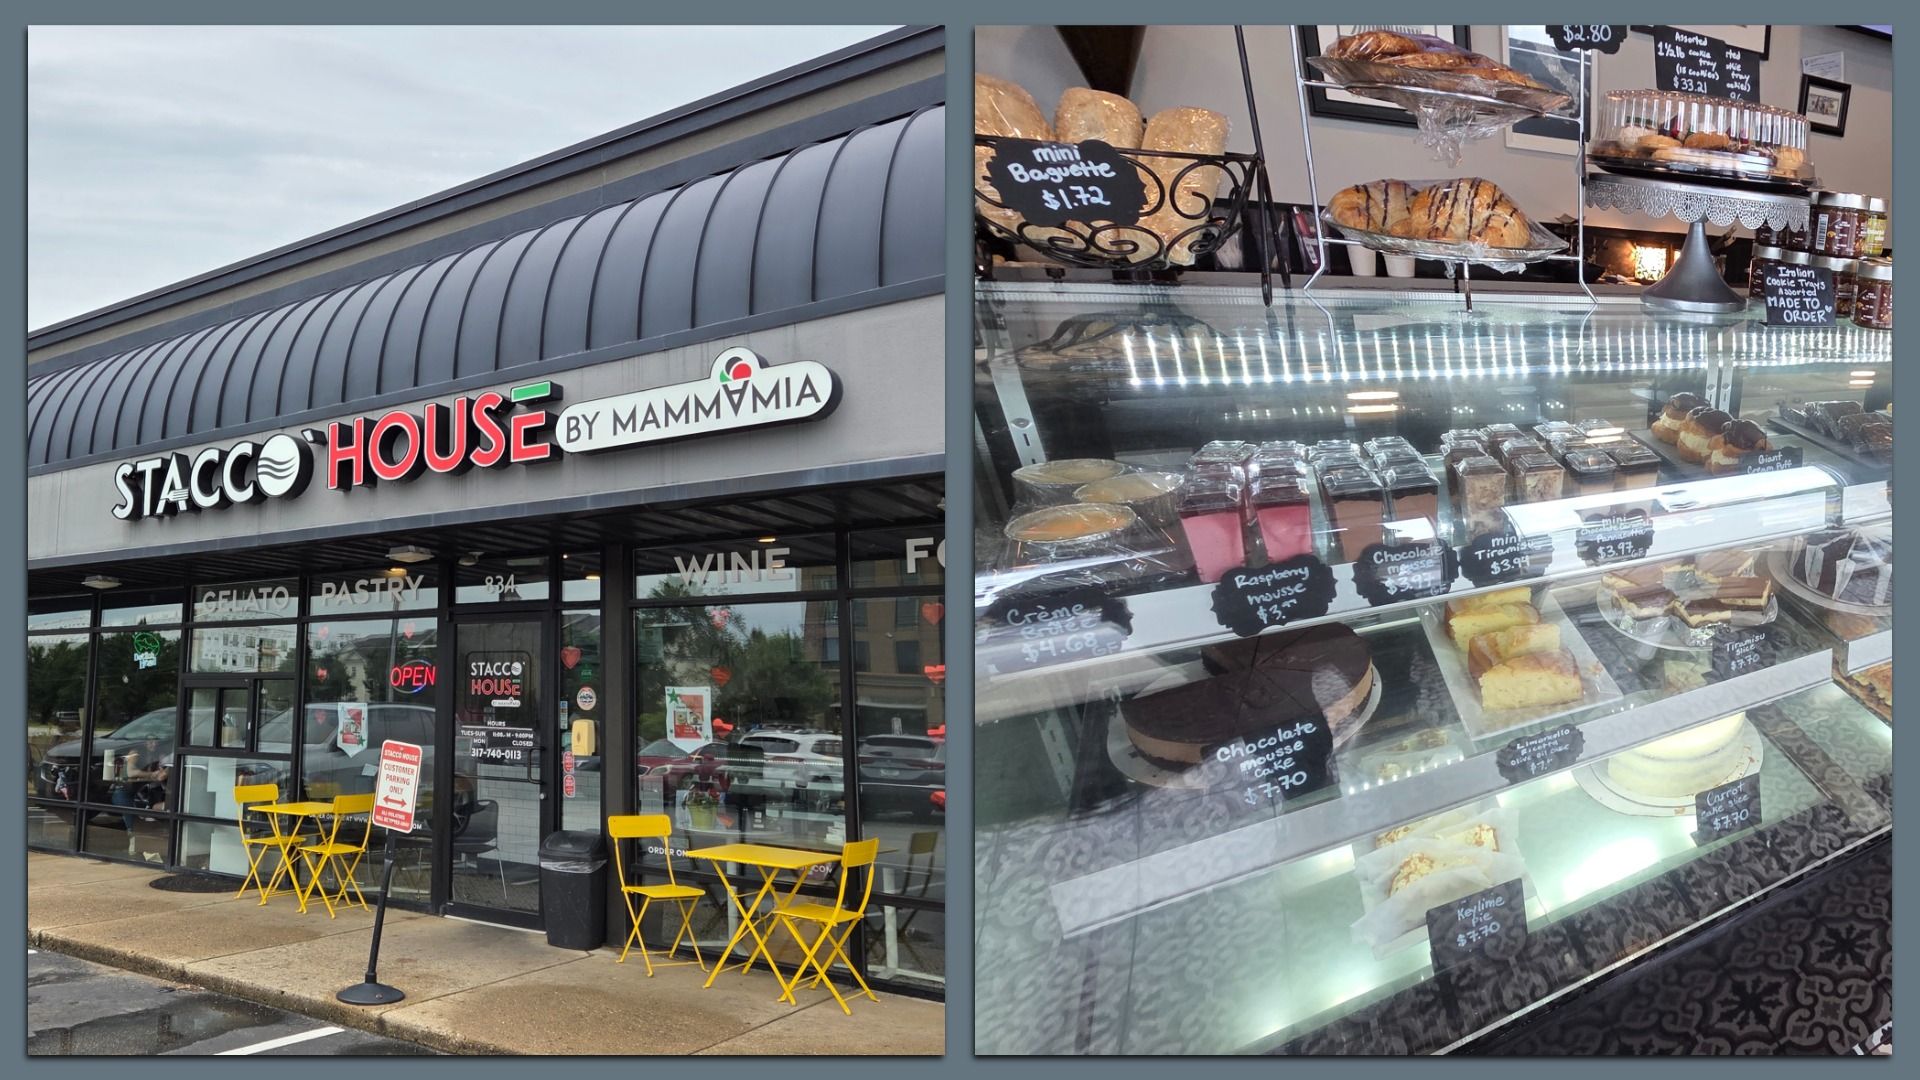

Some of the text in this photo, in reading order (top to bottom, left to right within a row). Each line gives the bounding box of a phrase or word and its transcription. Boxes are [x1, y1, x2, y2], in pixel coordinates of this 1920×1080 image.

[1563, 25, 1612, 43] $2.80
[1674, 31, 1708, 46] Assorted
[1698, 58, 1717, 72] tray
[1673, 75, 1707, 94] $33.21
[1032, 145, 1081, 162] mini
[1007, 161, 1116, 183] Baguette
[1042, 185, 1111, 210] $1.72
[1777, 266, 1815, 279] Italian
[1767, 296, 1820, 310] MADE TO
[1783, 309, 1827, 323] ORDER
[327, 381, 564, 491] HOUSE
[565, 409, 601, 446] BY
[611, 372, 823, 437] MAMMAMIA
[1758, 451, 1783, 464] Giant
[1776, 459, 1793, 470] Puff
[1474, 540, 1534, 560] Tiramisu
[1491, 534, 1522, 547] mini
[1597, 541, 1634, 559] $3.97
[1372, 546, 1444, 564] Chocolate
[674, 547, 791, 586] WINE
[485, 574, 517, 594] 834
[1234, 566, 1310, 589] Raspberry
[1384, 572, 1435, 596] $3.97
[202, 586, 290, 613] GELATO
[321, 575, 425, 606] PASTRY
[1247, 582, 1307, 605] mousse
[1022, 632, 1098, 663] $4.68
[1724, 633, 1766, 652] Tiramisu
[1730, 653, 1761, 671] $7.70
[390, 665, 436, 687] OPEN
[471, 678, 521, 696] HOUSE
[1216, 722, 1317, 762] Chocolate
[471, 747, 522, 760] 317-740-0113
[1239, 740, 1305, 773] mousse
[384, 763, 415, 776] CUSTOMER
[1254, 757, 1296, 778] cake
[385, 773, 410, 786] PARKING
[1243, 771, 1308, 805] $7.70
[389, 785, 404, 796] ONLY
[1706, 782, 1746, 806] Carrot
[1701, 805, 1725, 818] cake
[1712, 809, 1750, 831] $7.70
[1471, 911, 1493, 927] pie
[1456, 921, 1501, 947] $7.70
